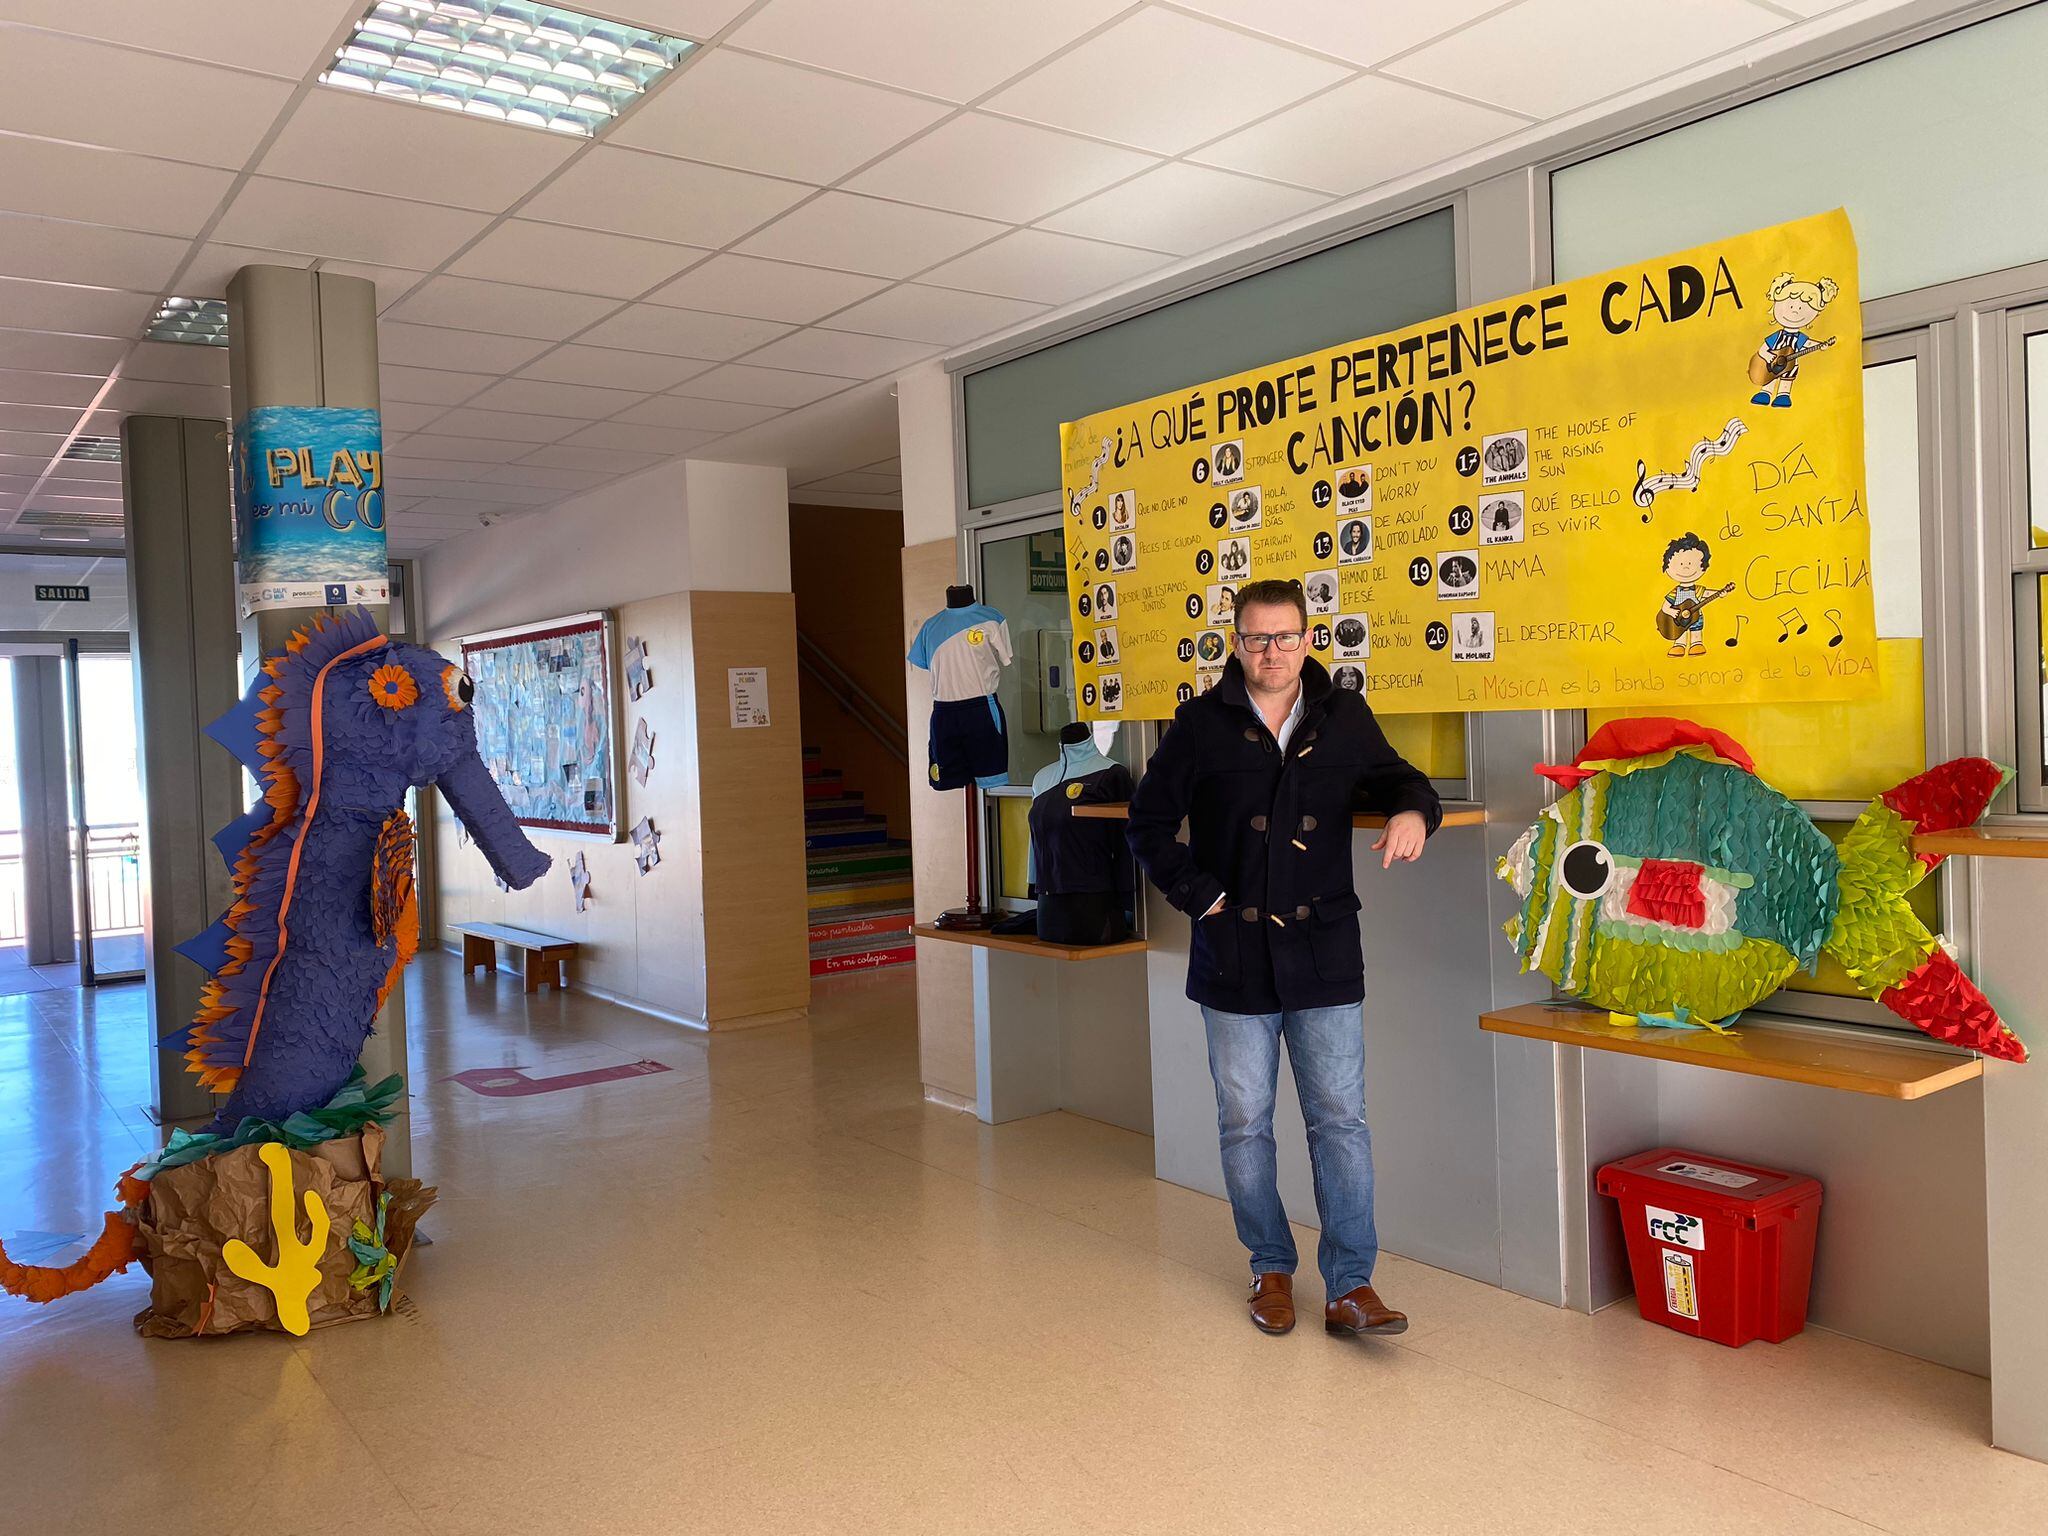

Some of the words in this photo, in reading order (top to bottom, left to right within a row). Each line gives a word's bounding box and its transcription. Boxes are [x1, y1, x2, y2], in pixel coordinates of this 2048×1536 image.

[1150, 392, 1206, 450] QUÉ
[1217, 365, 1317, 434] PROFE
[1330, 295, 1568, 403] PERTENECE
[1600, 256, 1743, 335] CADA
[1287, 379, 1476, 475] CANCIÓN?
[1535, 426, 1558, 440] THE
[1568, 417, 1610, 437] HOUSE
[1618, 412, 1637, 428] OF
[1245, 450, 1284, 470] STRONGER
[1535, 448, 1553, 463] THE
[1563, 441, 1604, 458] RISING
[266, 447, 381, 490] PLAY
[1196, 462, 1205, 480] 6
[1375, 462, 1410, 481] DON'T
[1416, 457, 1438, 471] YOU
[1458, 453, 1478, 472] 17
[1539, 463, 1566, 478] SUN
[1748, 442, 1818, 494] DÍA
[1498, 471, 1527, 481] ANIMALS
[1314, 485, 1330, 503] 12
[1379, 481, 1420, 503] WORRY
[1531, 492, 1560, 513] QUÉ
[1571, 489, 1621, 509] BELLO
[251, 503, 274, 518] es
[279, 497, 315, 516] mi
[1161, 498, 1176, 512] QUE
[1178, 496, 1188, 505] NO
[1265, 501, 1295, 516] BUENOS
[1095, 510, 1103, 526] 1
[1214, 508, 1223, 525] 7
[1265, 516, 1283, 528] DÍAS
[1374, 515, 1390, 528] DE
[1396, 504, 1427, 525] AQUÍ
[1451, 511, 1471, 530] 18
[1719, 510, 1744, 541] de
[1761, 490, 1864, 531] SANTA
[1375, 537, 1386, 551] AL
[1387, 530, 1408, 548] OTRO
[1412, 525, 1439, 543] LADO
[1532, 521, 1549, 537] ES
[1139, 542, 1160, 554] PECES
[1162, 541, 1172, 550] DE
[1254, 534, 1292, 550] STAIRWAY
[1316, 537, 1331, 554] 13
[1098, 552, 1105, 568] 2
[1200, 553, 1209, 571] 8
[1254, 557, 1263, 567] TO
[1266, 549, 1297, 564] HEAVEN
[1373, 566, 1388, 581] DEL
[1411, 563, 1429, 581] 19
[1485, 554, 1546, 584] MAMA
[1745, 555, 1870, 601] CECILIA
[39, 588, 85, 599] SALIDA
[1118, 592, 1140, 606] DESDE
[1142, 587, 1154, 599] QUE
[1155, 580, 1188, 596] ESTAMOS
[1342, 587, 1375, 606] EFESÉ
[1082, 598, 1088, 613] 3
[1140, 599, 1167, 613] JUNTOS
[1190, 598, 1199, 615] 9
[1370, 612, 1384, 628] WE
[1389, 609, 1411, 625] WILL
[1121, 629, 1168, 649] CANTARES
[1313, 629, 1329, 646] 15
[1394, 632, 1412, 648] YOU
[1428, 627, 1446, 645] 20
[1497, 626, 1515, 644] EL
[1520, 621, 1623, 644] DESPERTAR
[1083, 644, 1091, 659] 4
[1179, 643, 1193, 658] 10
[1366, 669, 1424, 692] DESPECHÁ
[1456, 675, 1478, 701] La
[1561, 680, 1581, 694] es
[1587, 669, 1601, 694] la
[1614, 667, 1665, 693] banda
[1678, 668, 1744, 688] sonora
[1759, 658, 1784, 680] de
[1794, 656, 1811, 677] la
[1086, 686, 1093, 703] 5
[826, 958, 840, 969] En
[843, 956, 856, 966] mi
[1650, 1218, 1688, 1245] FCC
